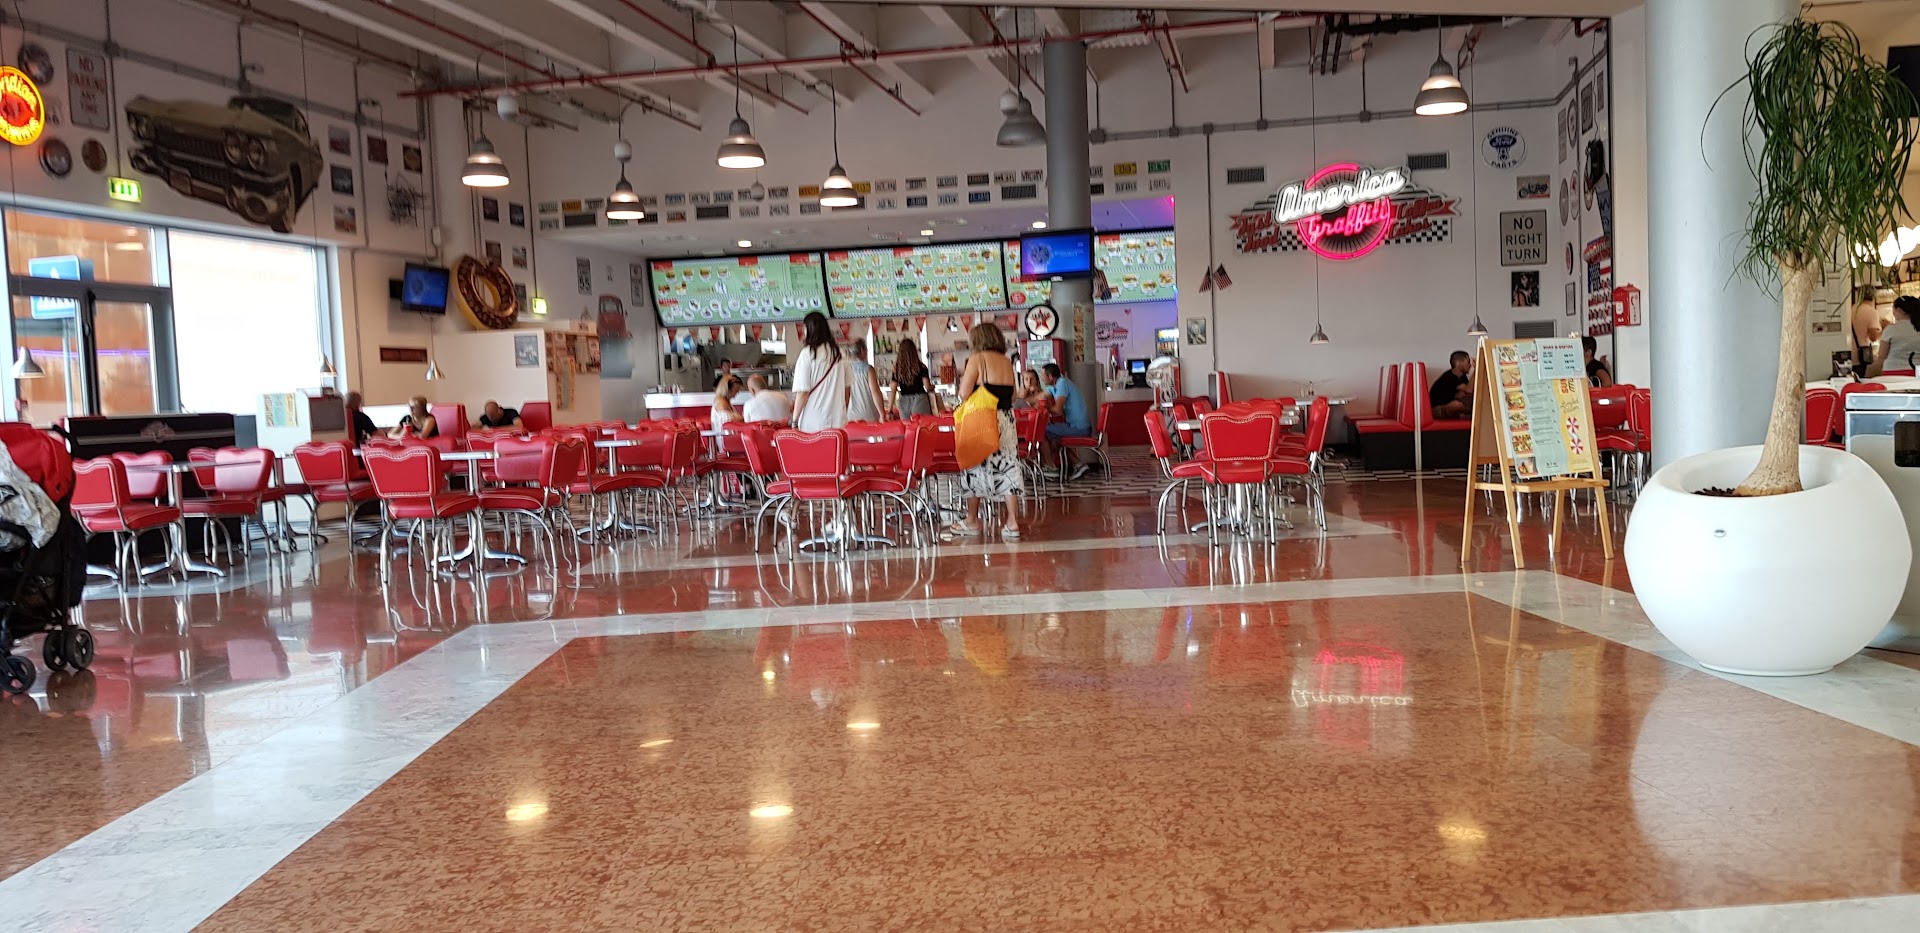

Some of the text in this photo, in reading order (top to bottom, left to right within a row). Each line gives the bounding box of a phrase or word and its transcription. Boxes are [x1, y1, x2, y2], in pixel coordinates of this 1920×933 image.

[1487, 126, 1519, 140] GENUINE
[1492, 136, 1513, 147] Ford
[1491, 159, 1517, 169] PARTS
[1279, 168, 1406, 222] America
[1303, 198, 1388, 243] Graffiti
[1513, 217, 1534, 230] NO
[1388, 217, 1431, 239] Cakes
[1505, 233, 1543, 245] RIGHT
[1506, 248, 1541, 260] TURN
